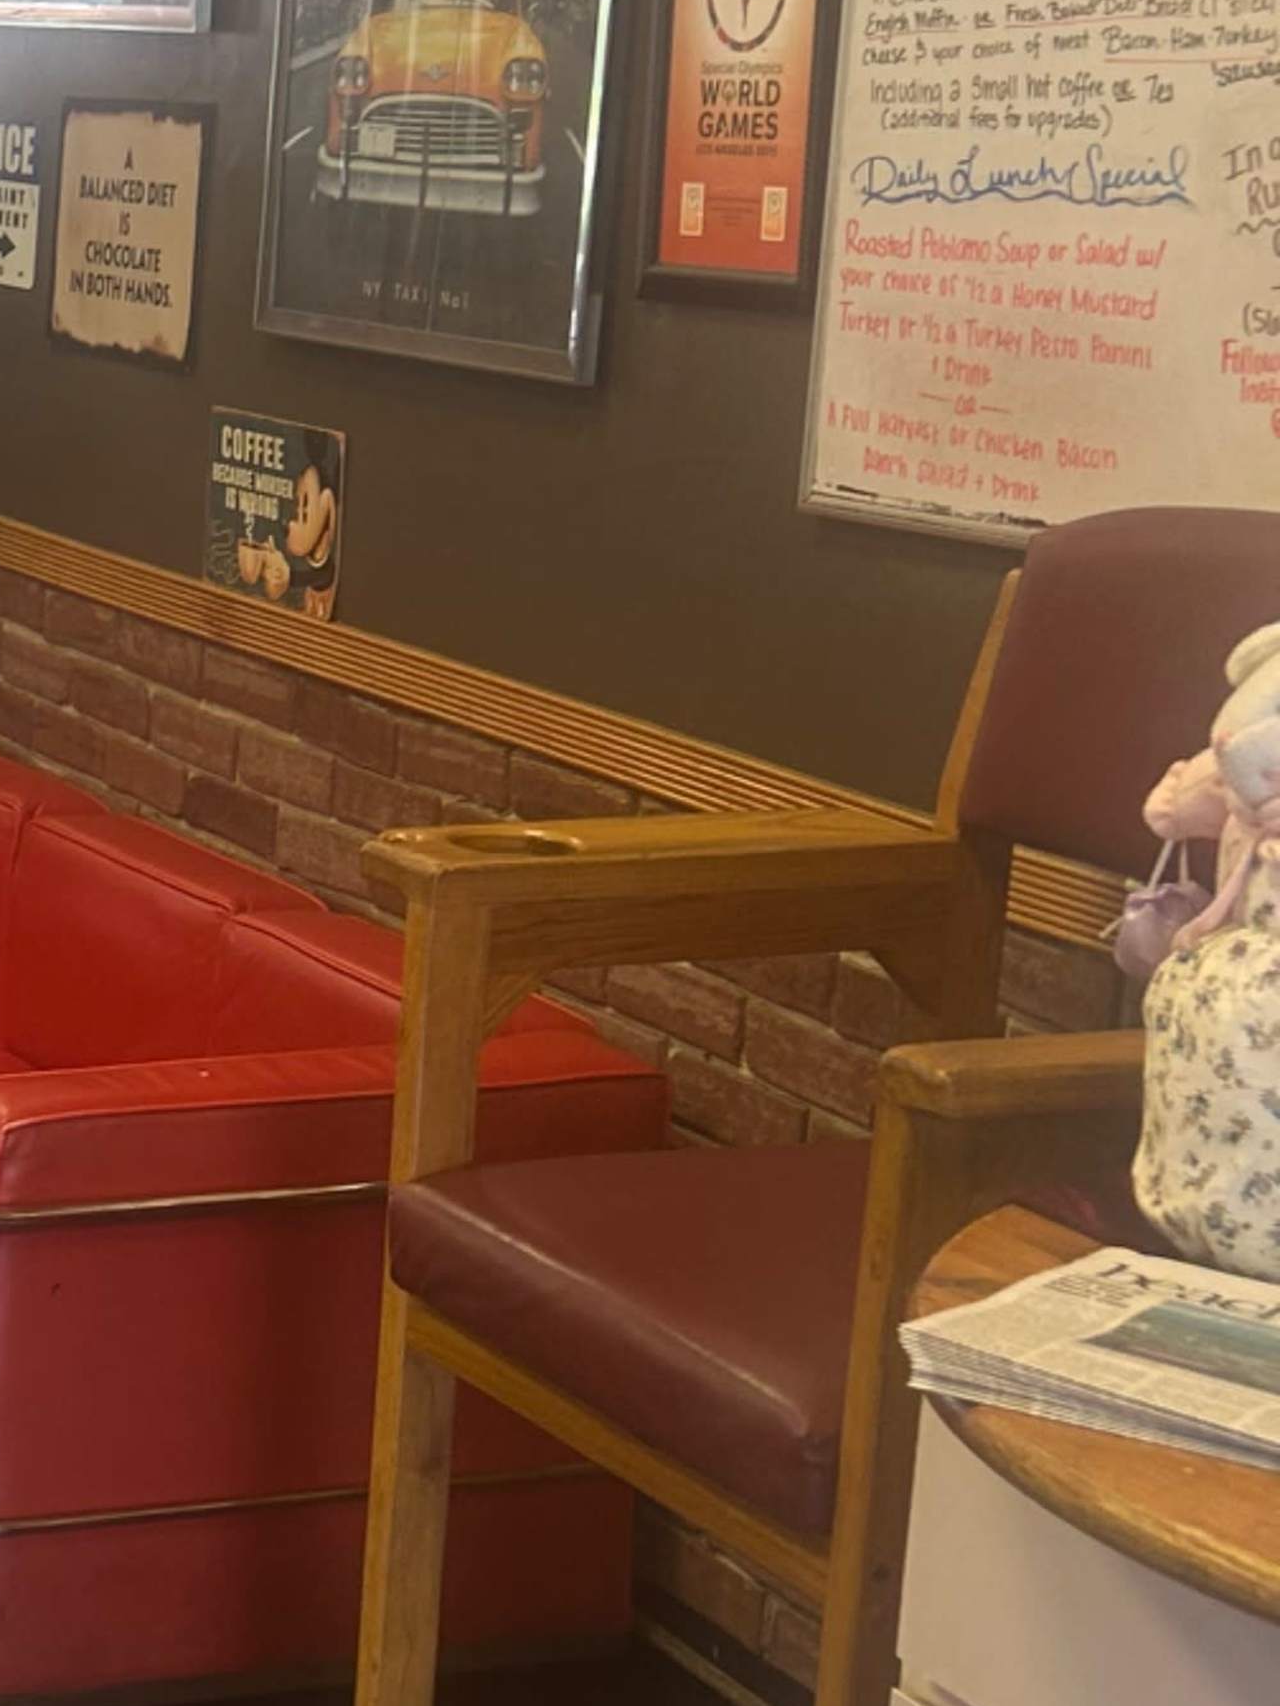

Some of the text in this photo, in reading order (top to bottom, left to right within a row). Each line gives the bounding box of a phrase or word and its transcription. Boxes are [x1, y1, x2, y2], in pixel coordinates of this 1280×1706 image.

[932, 44, 964, 67] your
[972, 41, 1015, 59] choice
[1025, 32, 1042, 60] of
[1101, 25, 1158, 54] Bacon
[739, 60, 783, 78] Olympics
[700, 79, 781, 107] WORLD
[871, 77, 942, 106] Including
[949, 79, 961, 102] a
[1026, 73, 1051, 99] hot
[1058, 71, 1105, 107] coffee
[1145, 74, 1174, 104] Tea
[698, 110, 779, 141] GAMES
[968, 105, 999, 131] fees
[1003, 104, 1021, 130] for
[124, 146, 134, 172] A
[850, 142, 1189, 203] Daily Lunch Special
[80, 174, 178, 209] BALANCED DIET
[118, 209, 131, 237] IS
[85, 239, 163, 274] CHOCOLATE
[845, 218, 1167, 270] Roasted Soup or Salad w/
[69, 269, 174, 309] IN BOTH HANDS.
[840, 267, 875, 294] your
[882, 270, 933, 295] choice
[939, 273, 959, 297] of
[991, 284, 1004, 305] a
[1011, 281, 1063, 312] Honey
[1070, 285, 1158, 321] Mustard
[838, 300, 891, 342] Turkey
[898, 315, 917, 340] or
[944, 323, 958, 344] a
[964, 317, 1024, 357] Turkey
[1030, 325, 1080, 360] Pesto
[1090, 332, 1153, 372] Panini
[944, 355, 993, 386] Drink
[220, 423, 286, 471] COFFEE
[826, 401, 837, 427] A
[949, 423, 968, 446] or
[974, 426, 1044, 461] Chicken
[1056, 436, 1119, 471] Bacon
[992, 472, 1040, 503] Drink
